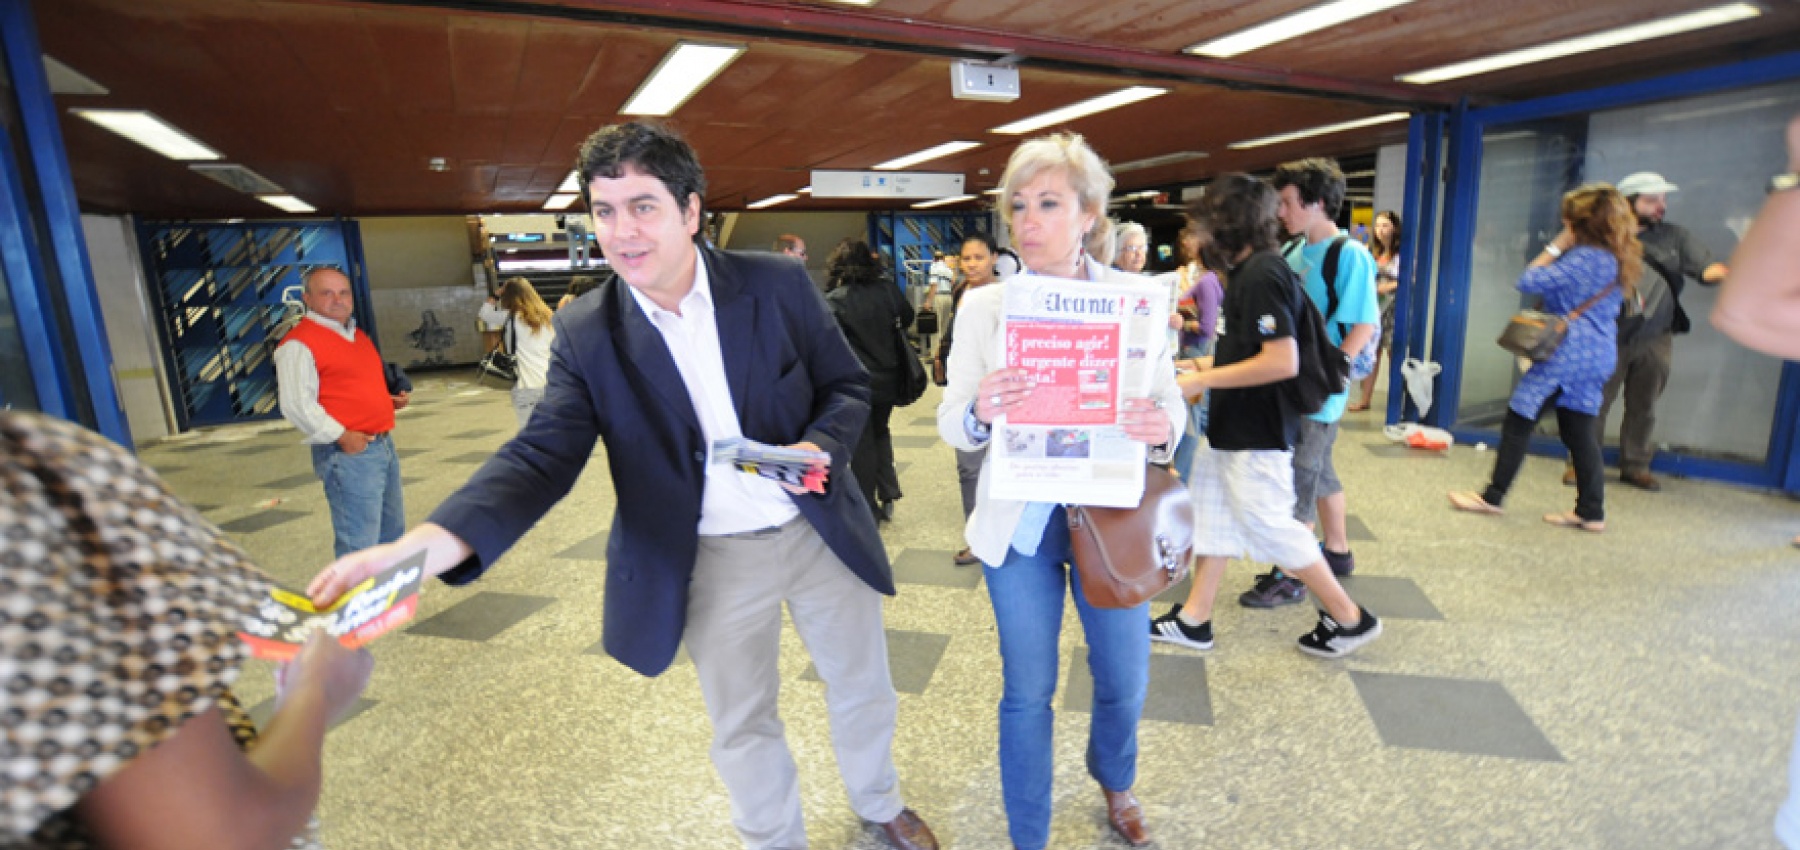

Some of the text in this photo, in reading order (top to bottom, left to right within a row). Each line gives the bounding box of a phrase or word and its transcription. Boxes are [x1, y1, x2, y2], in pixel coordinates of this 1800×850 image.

[1022, 335, 1073, 352] preciso
[1076, 334, 1109, 355] agir!
[1022, 356, 1076, 370] urgente
[1079, 353, 1118, 368] dizer
